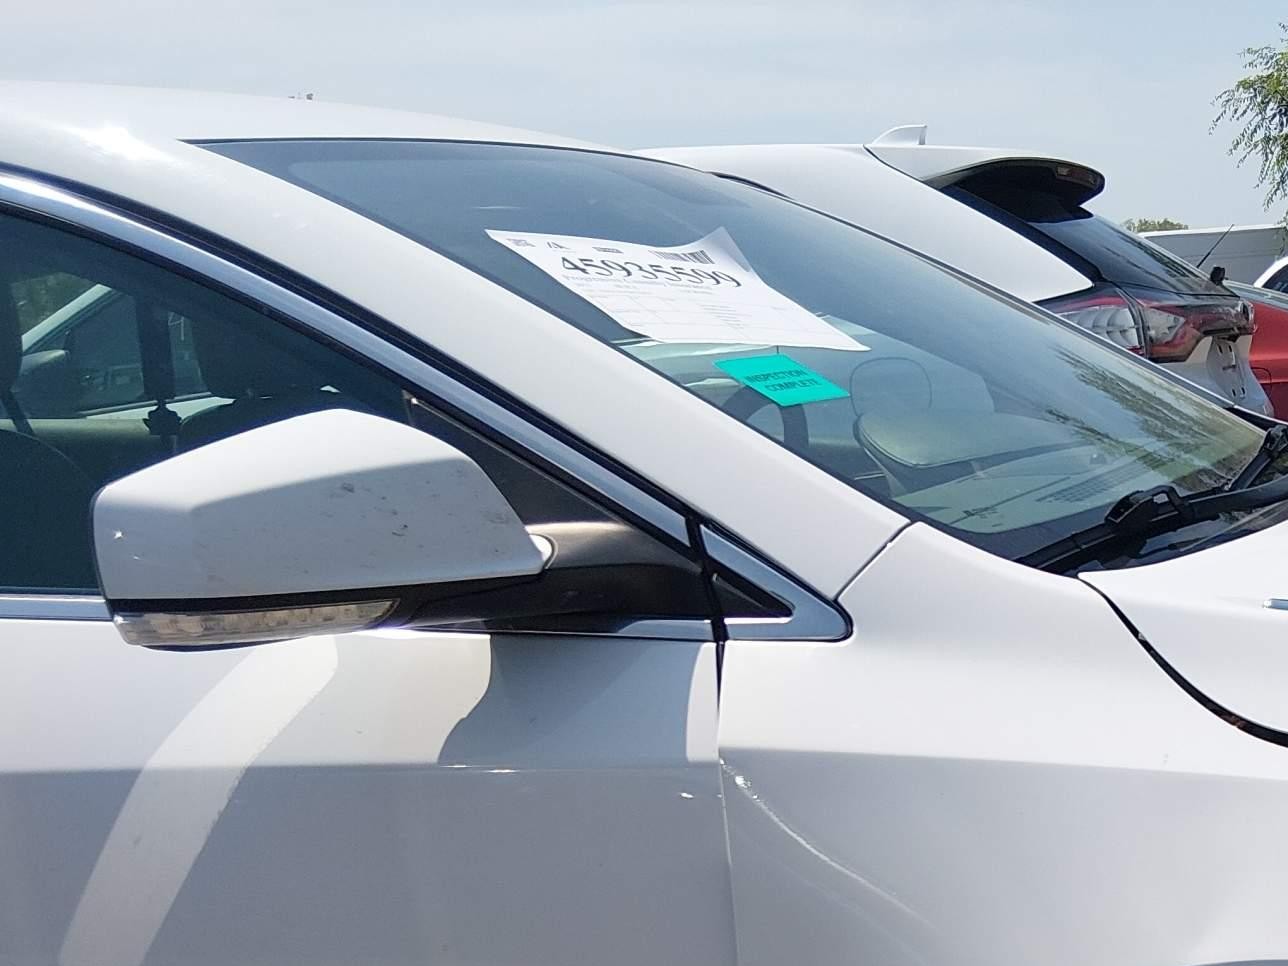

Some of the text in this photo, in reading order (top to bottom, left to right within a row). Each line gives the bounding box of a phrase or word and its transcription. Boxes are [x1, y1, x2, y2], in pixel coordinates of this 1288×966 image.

[561, 256, 742, 288] 45935599
[743, 369, 808, 383] INSPECTION
[764, 378, 822, 392] COMPLETE
